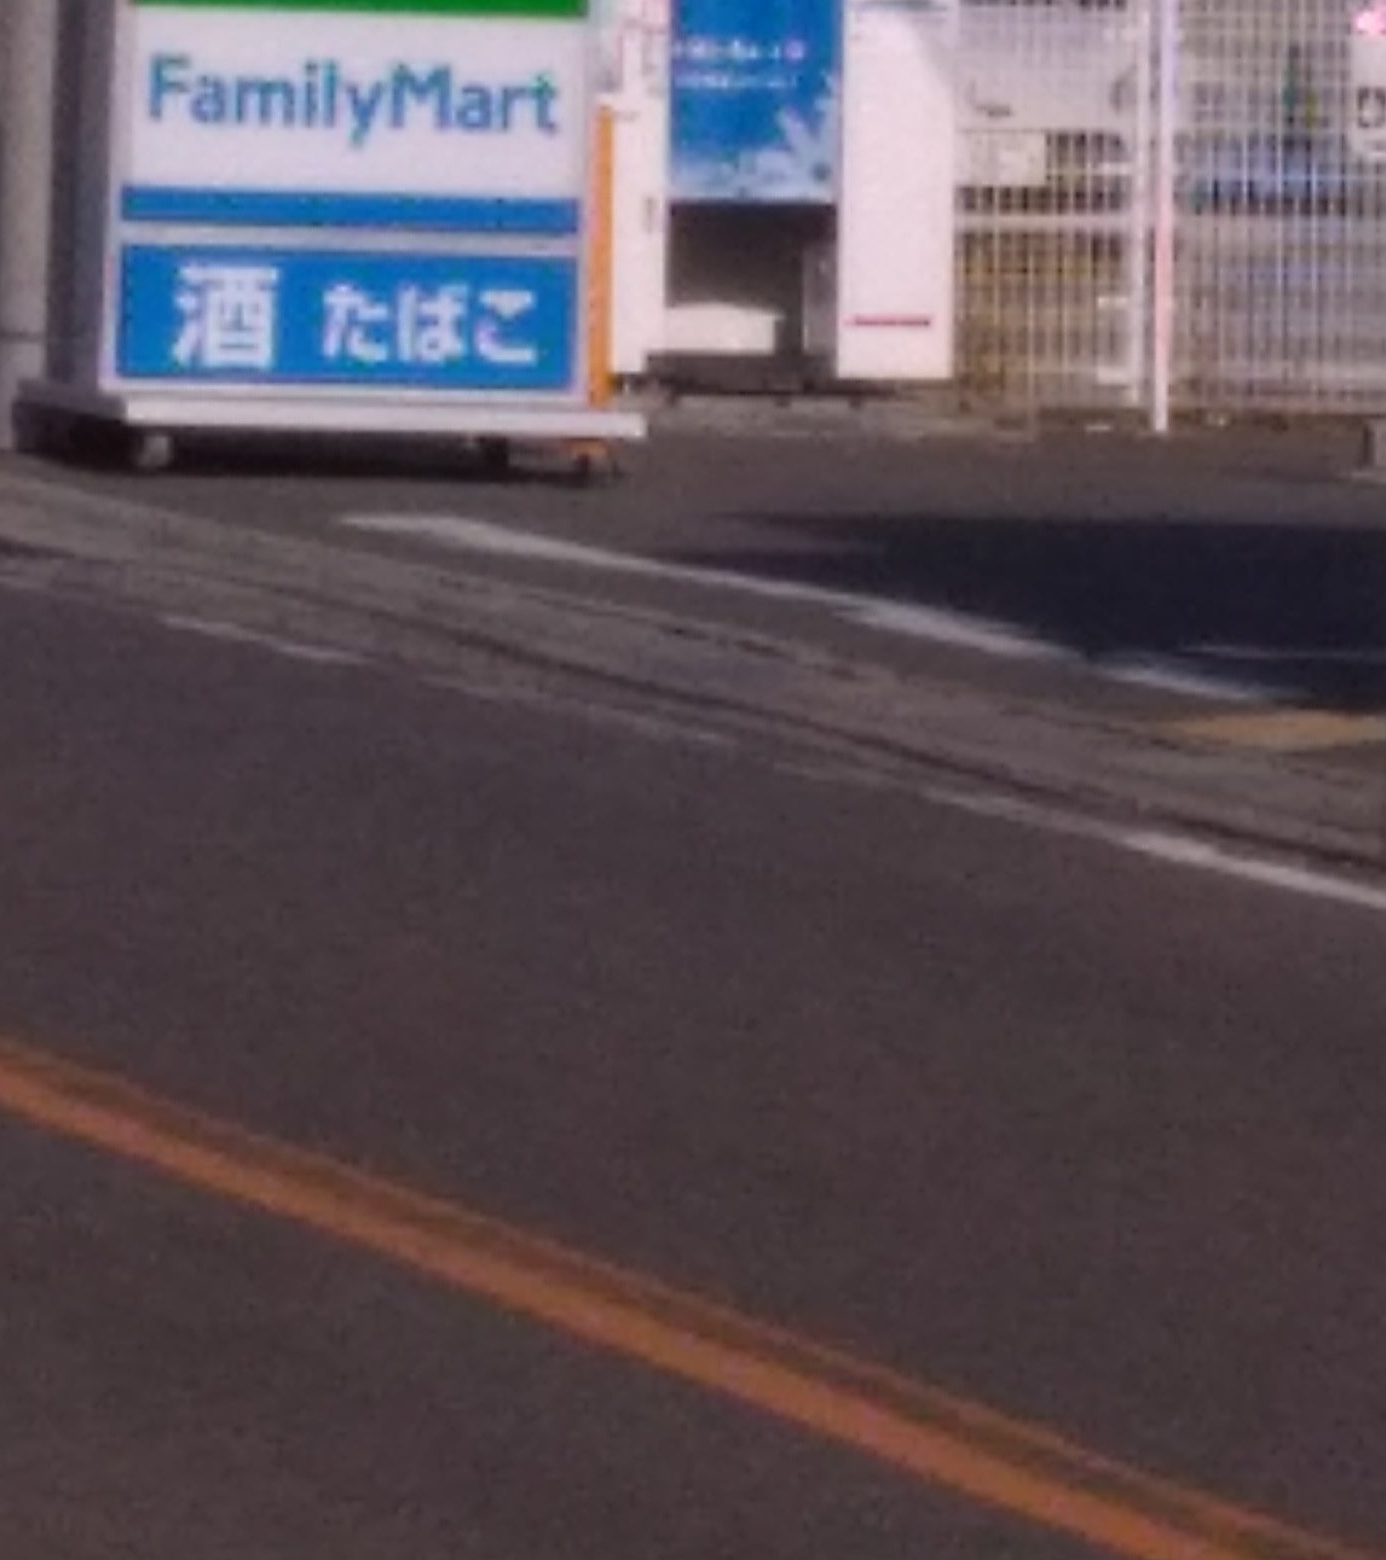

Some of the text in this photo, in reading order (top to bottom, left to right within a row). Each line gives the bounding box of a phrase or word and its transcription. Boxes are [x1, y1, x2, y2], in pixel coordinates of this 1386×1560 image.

[147, 52, 559, 149] FamilyMart
[171, 263, 539, 371] 酒 たばこ
